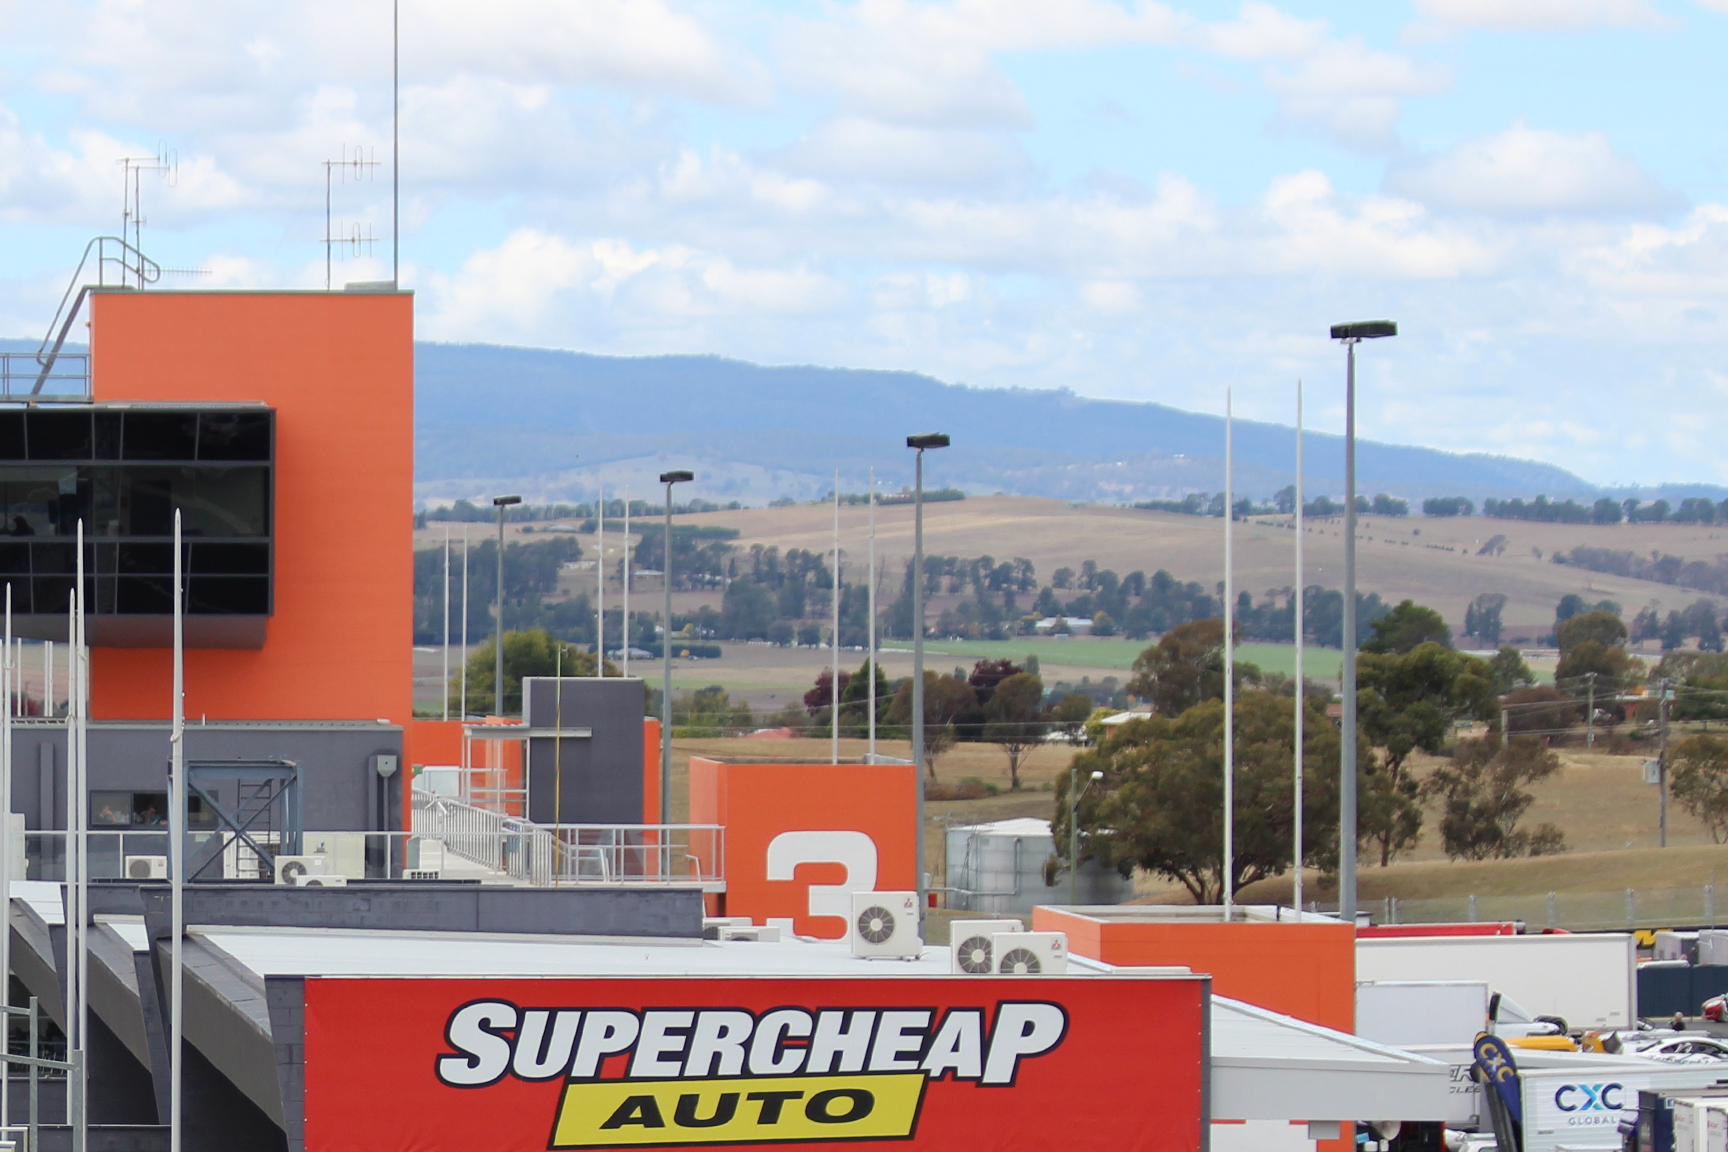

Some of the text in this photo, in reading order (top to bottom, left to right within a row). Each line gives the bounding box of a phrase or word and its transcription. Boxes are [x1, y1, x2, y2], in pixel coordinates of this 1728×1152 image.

[767, 831, 877, 944] 3
[439, 1003, 1065, 1084] SUPERCHEAP
[600, 1089, 876, 1129] AUTO
[1555, 1083, 1623, 1112] CXC
[1569, 1116, 1617, 1126] GLOBAL
